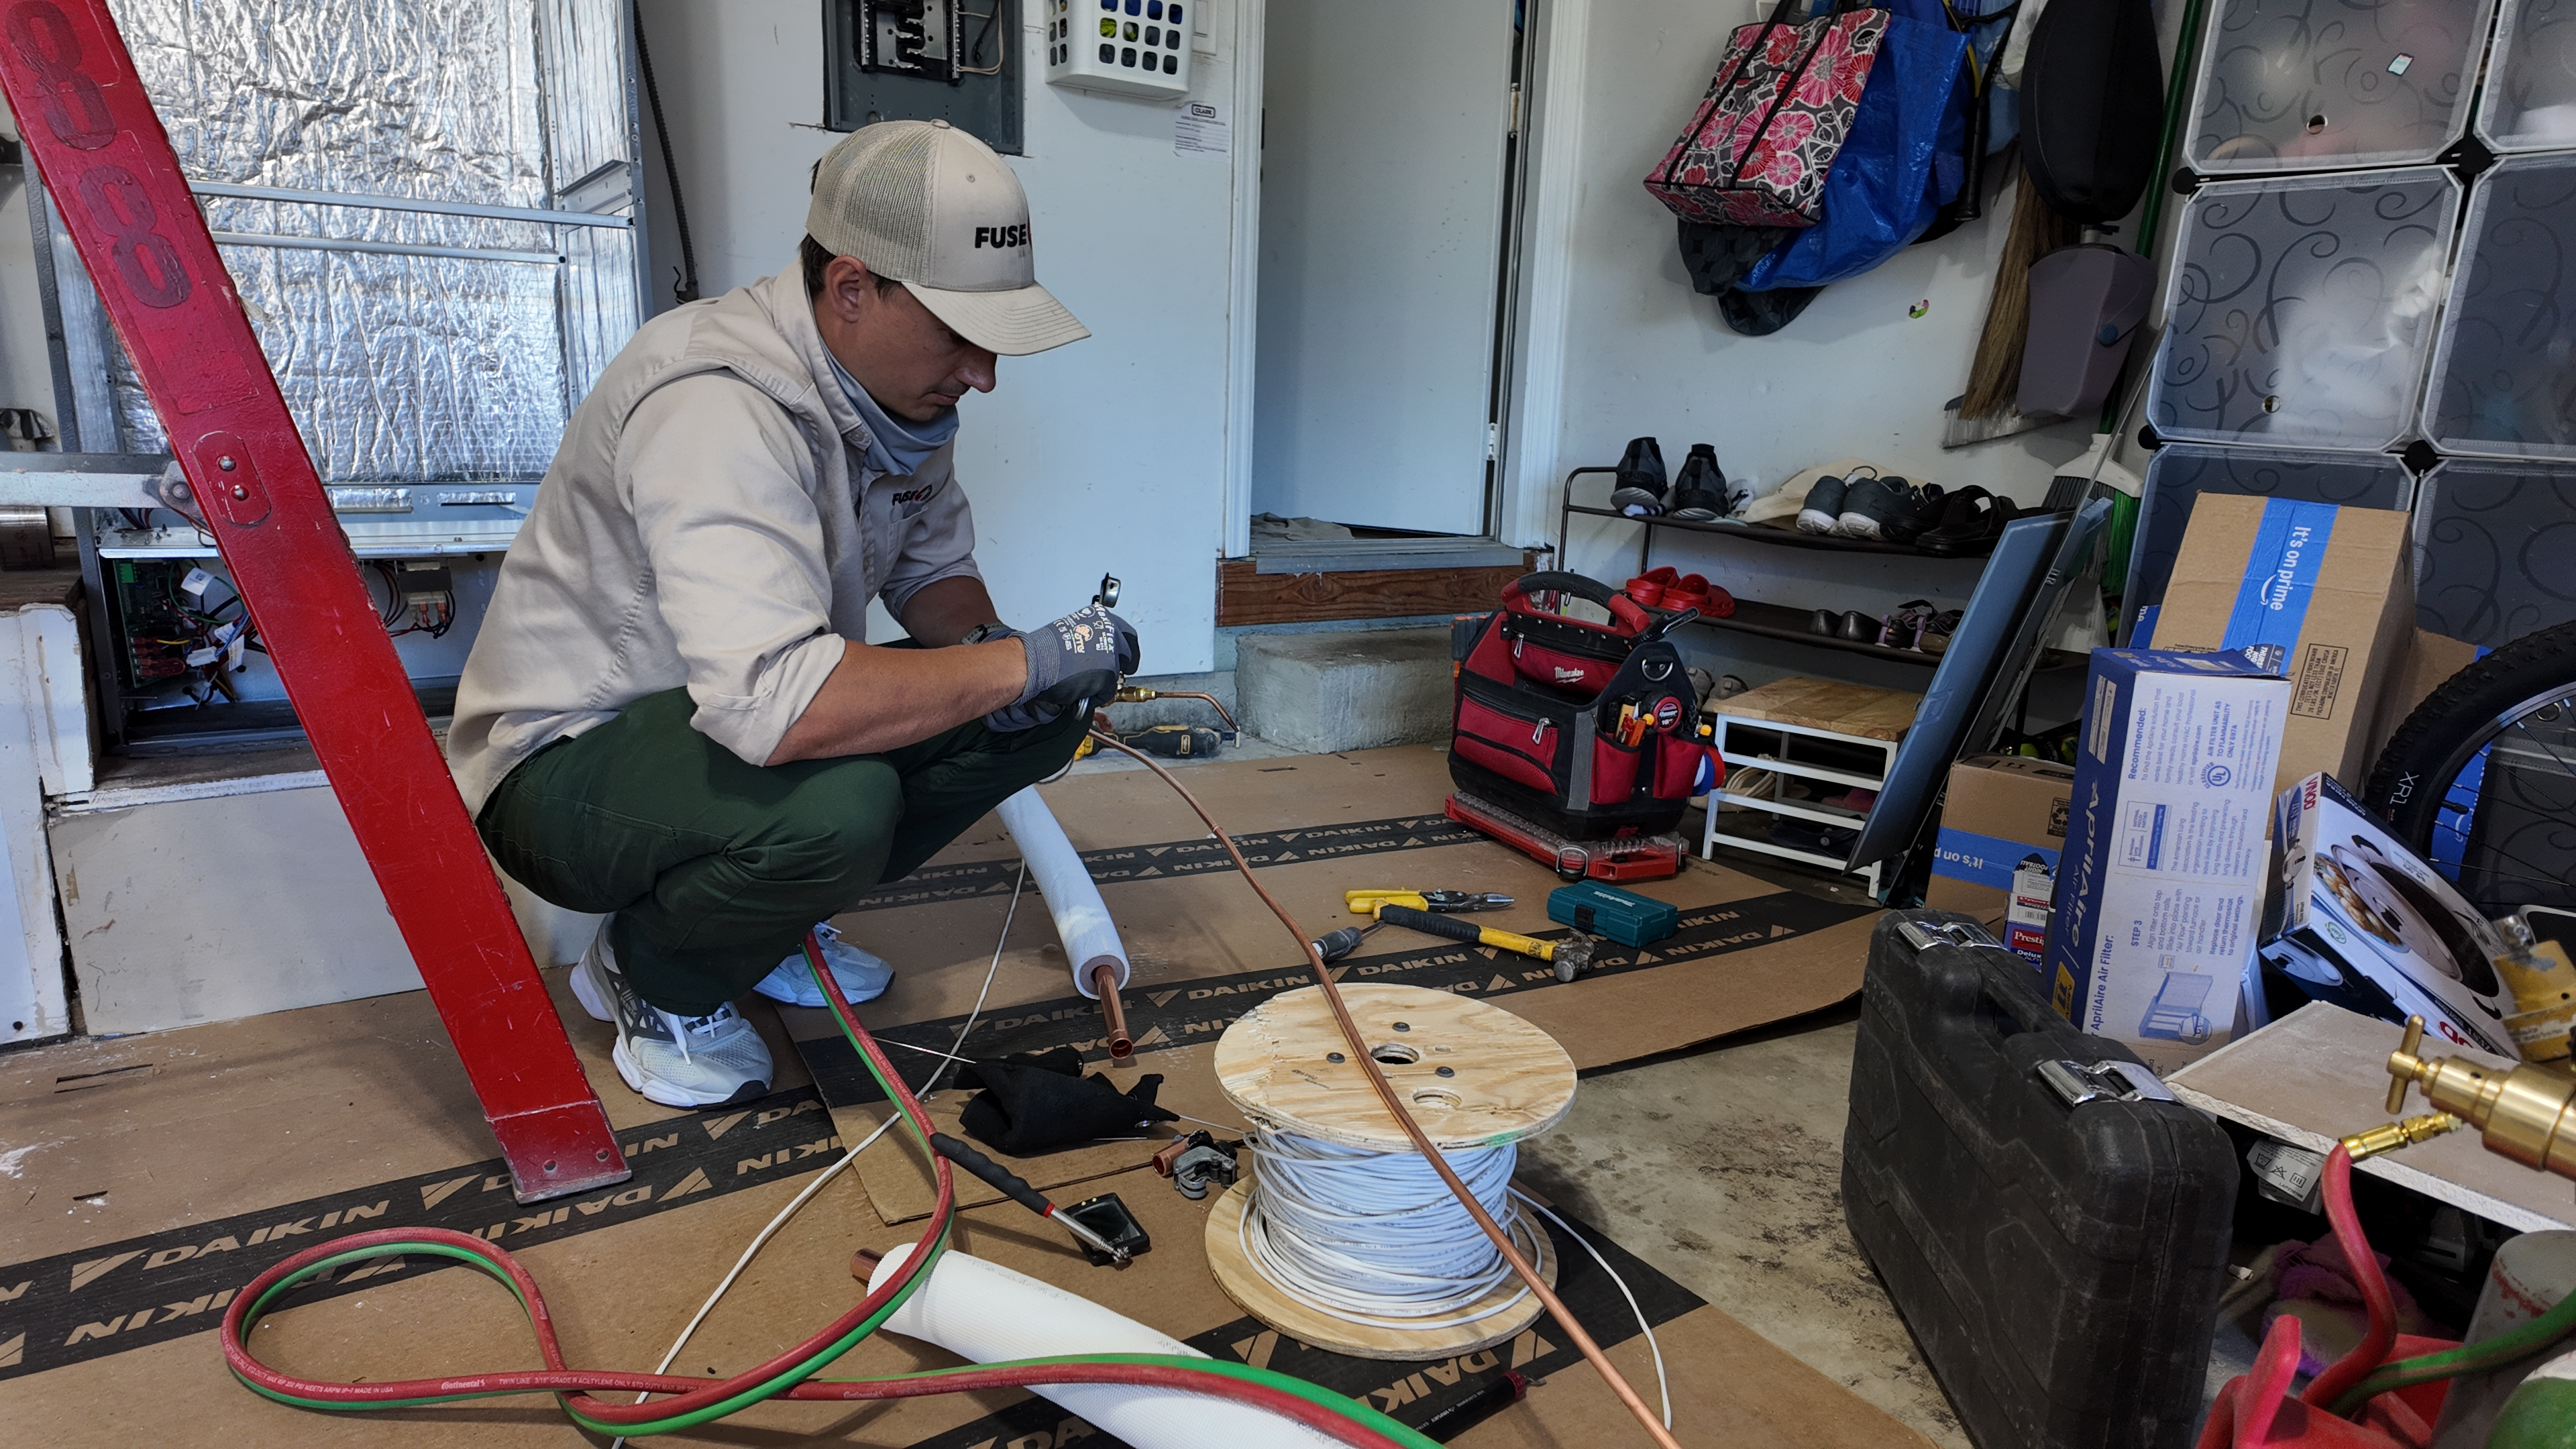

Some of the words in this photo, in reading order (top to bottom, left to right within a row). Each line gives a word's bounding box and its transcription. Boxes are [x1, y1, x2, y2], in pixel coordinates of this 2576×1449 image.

[1195, 107, 1212, 115] CLARK
[975, 223, 1028, 249] FUSE
[2290, 527, 2311, 547] It's
[2283, 551, 2300, 567] on
[2270, 570, 2294, 610] prime
[2255, 646, 2269, 669] THURS
[2153, 688, 2161, 700] that
[2150, 702, 2159, 724] solution
[2184, 688, 2196, 724] Professional
[2214, 701, 2221, 709] AS
[2212, 711, 2220, 724] UNIT
[2218, 703, 2231, 747] FLAMMABILITY
[2182, 726, 2190, 742] HVAC
[2208, 727, 2217, 745] FILTER
[2153, 765, 2161, 782] works
[2161, 709, 2169, 727] home
[2164, 765, 2174, 784] family
[2170, 722, 2179, 743] consult
[2179, 743, 2188, 760] Home
[2190, 725, 2203, 765] aprilaire.com
[2206, 746, 2214, 756] AIR
[2216, 748, 2224, 757] TO
[2226, 741, 2235, 757] ONLY
[2142, 761, 2150, 772] find
[2175, 762, 2186, 784] Healthy
[2211, 770, 2226, 781] UL
[2304, 776, 2318, 810] VINOD
[2390, 771, 2420, 804] XR1
[2208, 809, 2219, 838] improving
[2219, 800, 2231, 829] preventing
[1081, 853, 1135, 863] KIN
[1176, 838, 1269, 853] DAIIN
[1305, 824, 1391, 839] DAIKIN
[2172, 833, 2182, 859] American
[2178, 818, 2186, 832] Lung
[2182, 840, 2192, 872] Association
[2189, 802, 2200, 823] leading
[2192, 839, 2203, 873] organization
[2198, 816, 2207, 837] working
[2222, 863, 2231, 875] lung
[2228, 816, 2238, 838] through
[1308, 840, 1397, 855] DAIKIN
[1943, 851, 1960, 861] on
[2214, 843, 2222, 861] health
[2233, 851, 2241, 876] research
[2237, 821, 2246, 850] education
[1962, 855, 1983, 869] It's
[2021, 860, 2048, 870] FOOTBALL
[2072, 777, 2098, 947] AprilAire
[2212, 863, 2220, 875] lung
[898, 867, 987, 882] AIKIN
[859, 886, 975, 906] DAIKIN
[2155, 890, 2163, 900] top
[2174, 888, 2182, 902] with
[2216, 898, 2224, 911] and
[2064, 892, 2076, 936] Filter
[2151, 902, 2160, 916] onto
[2169, 903, 2181, 921] place
[2180, 896, 2192, 922] pointing
[2189, 904, 2199, 928] furnace
[2222, 898, 2233, 934] thermostat
[2149, 918, 2158, 931] filter
[2159, 912, 2168, 936] bottom
[2167, 922, 2176, 934] into
[2213, 912, 2222, 927] door
[1665, 931, 1764, 956] DAIKIN
[2014, 930, 2043, 946] Presti
[2130, 926, 2141, 946] STEP
[2147, 932, 2157, 949] Align
[2157, 936, 2165, 950] and
[2165, 935, 2174, 951] Slide
[2186, 930, 2195, 952] toward
[2209, 928, 2220, 954] Replace
[2218, 935, 2227, 955] return
[2229, 923, 2239, 947] original
[1188, 975, 1311, 1000] DAIKIN
[1356, 953, 1468, 976] DAIKIN
[1677, 910, 1741, 928] IKIN
[2017, 949, 2041, 959] Delux
[2099, 935, 2114, 965] Filter:
[2096, 966, 2108, 982] Air
[2089, 984, 2109, 1030] AprilAire
[737, 1136, 844, 1175] IKIN
[142, 1200, 390, 1273] DAIKIN
[255, 1369, 268, 1379] DUTY
[441, 1379, 479, 1390] Continental
[578, 1377, 613, 1386] ACETYLENE
[843, 1390, 878, 1399] Continental
